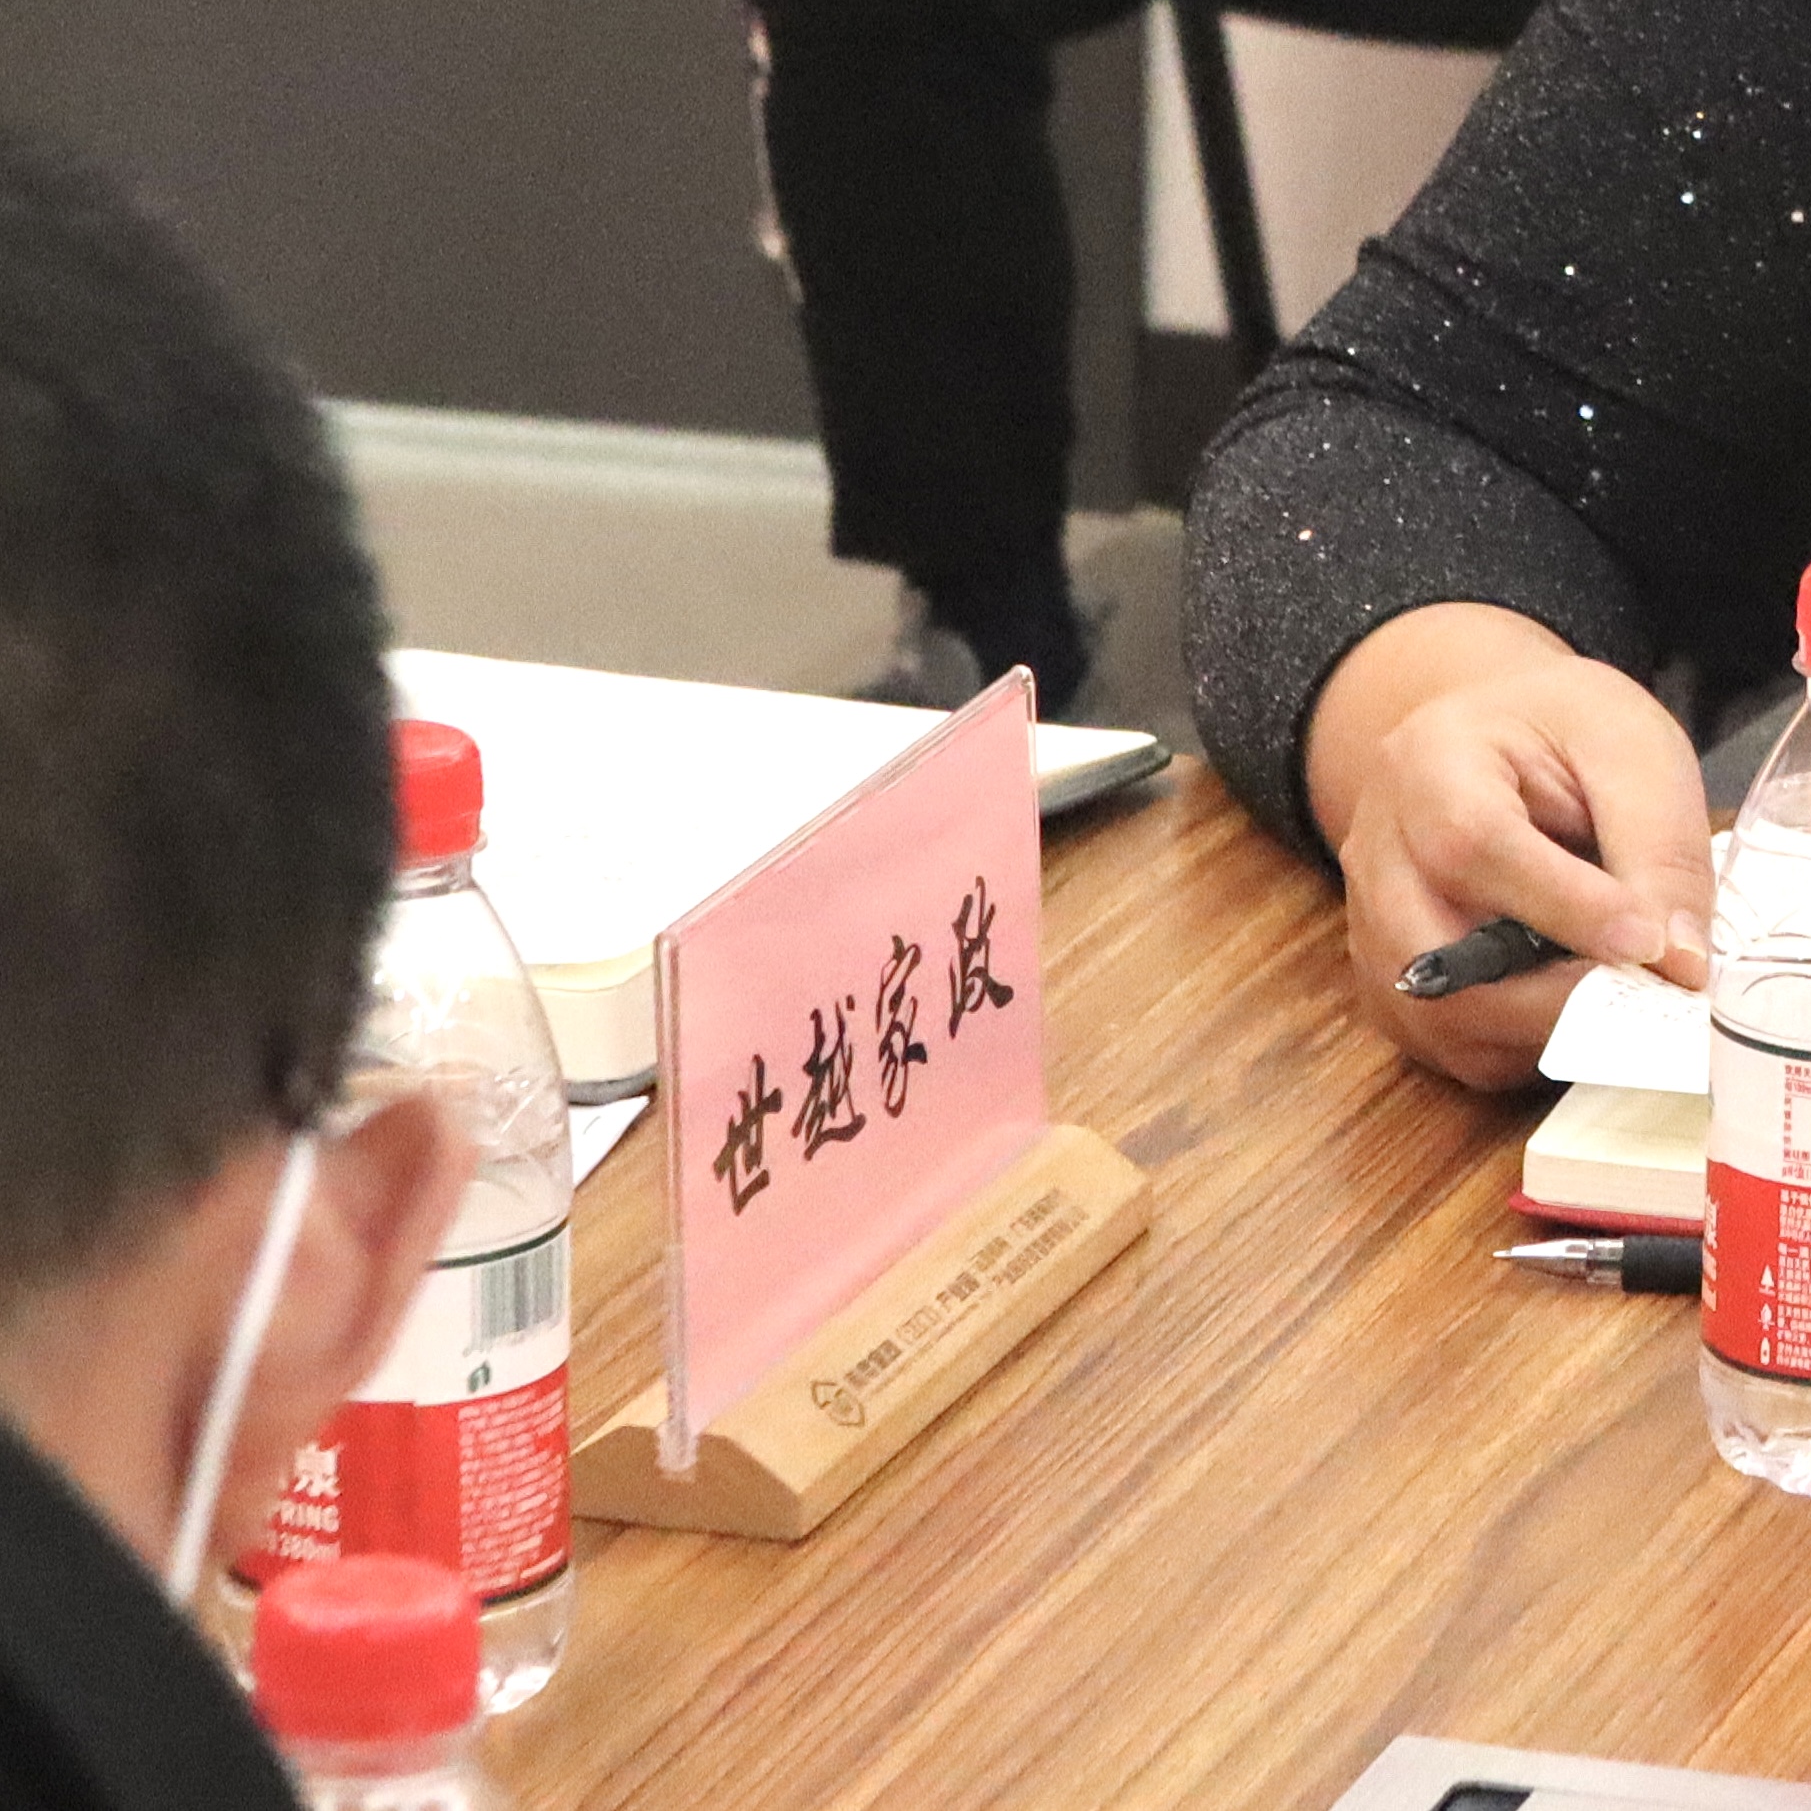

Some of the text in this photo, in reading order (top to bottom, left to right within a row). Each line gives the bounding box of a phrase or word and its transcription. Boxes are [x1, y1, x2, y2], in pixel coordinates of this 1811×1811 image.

[713, 875, 1015, 1217] 世越家政
[279, 1500, 340, 1533] RING
